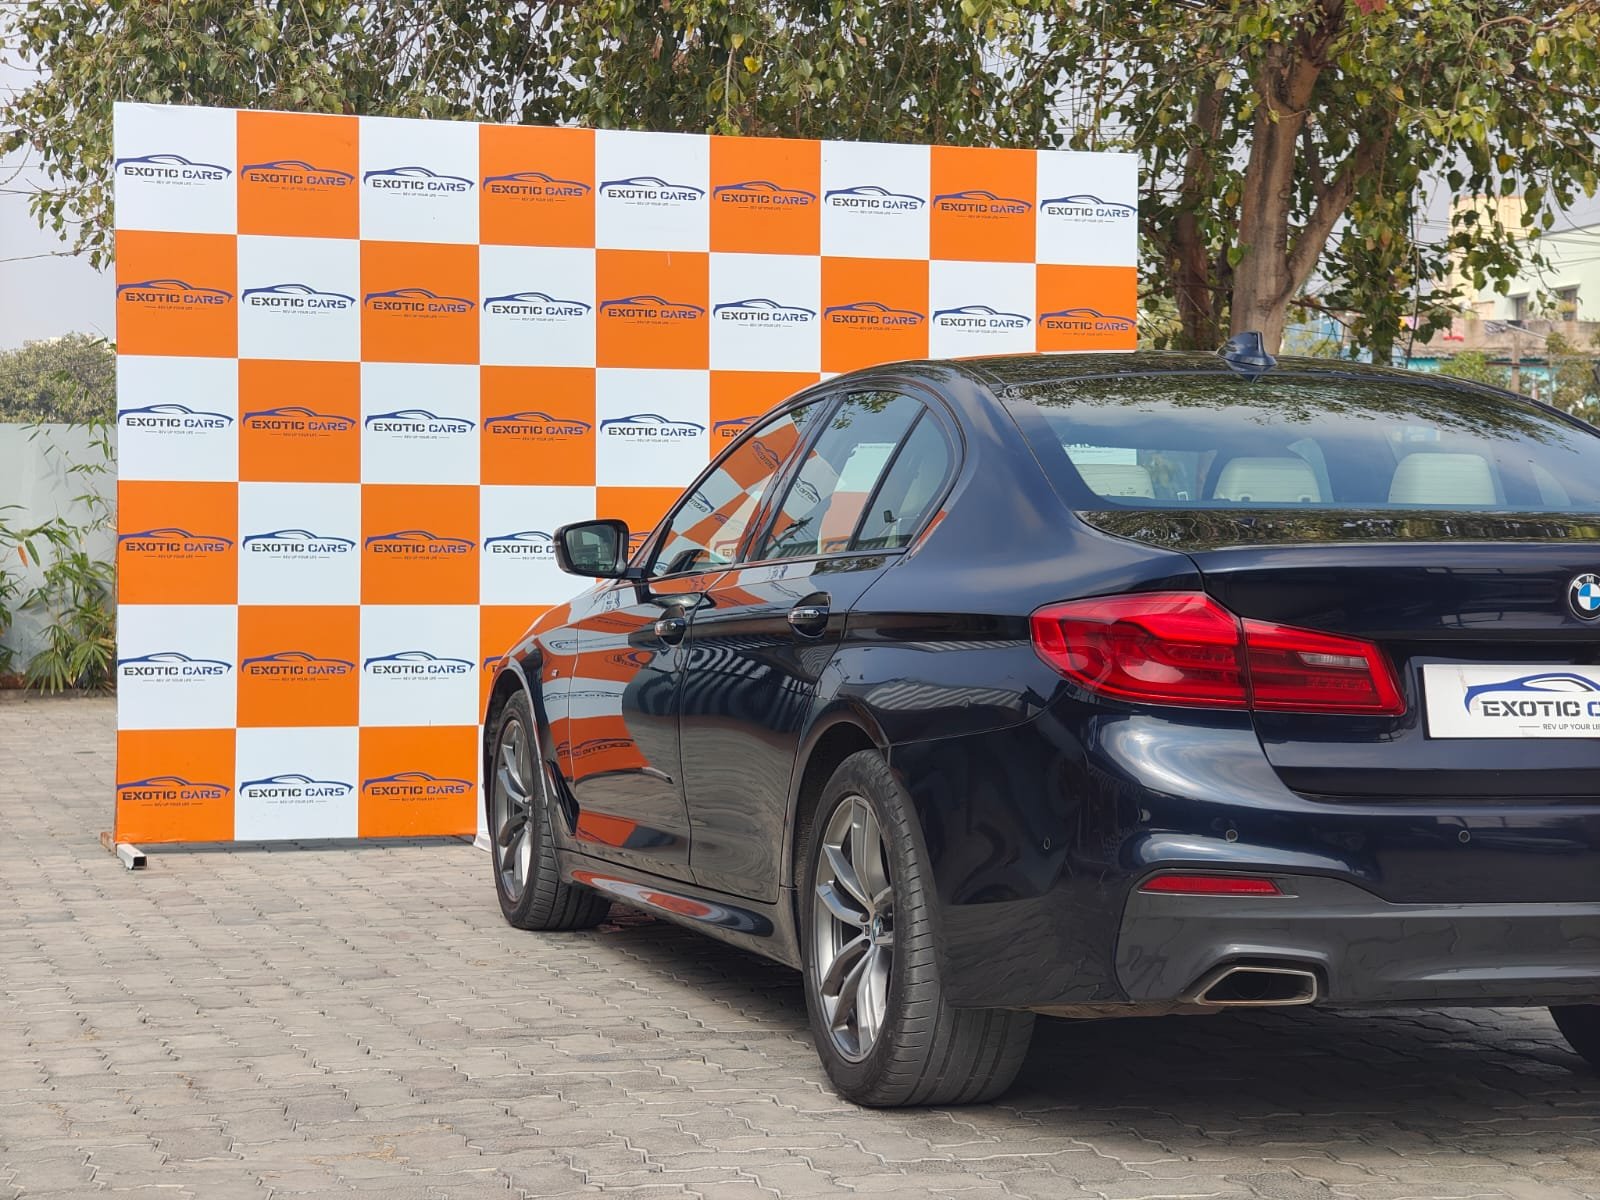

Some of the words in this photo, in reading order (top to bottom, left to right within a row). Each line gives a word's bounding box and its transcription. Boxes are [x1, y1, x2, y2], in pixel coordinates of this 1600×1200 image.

[124, 167, 179, 178] EXOTIC
[182, 169, 223, 180] CARS
[250, 173, 303, 184] EXOTIC
[307, 176, 346, 186] CARS
[372, 179, 424, 190] EXOTIC
[427, 182, 466, 192] CARS
[491, 185, 542, 195] EXOTIC
[545, 187, 583, 196] CARS
[607, 189, 657, 199] EXOTIC
[660, 191, 697, 201] CARS
[721, 194, 769, 204] EXOTIC
[773, 195, 808, 205] CARS
[832, 198, 879, 208] EXOTIC
[883, 200, 917, 210] CARS
[941, 203, 987, 212] EXOTIC
[990, 204, 1024, 214] CARS
[1047, 207, 1093, 216] EXOTIC
[1096, 208, 1130, 218] CARS
[125, 292, 180, 303] EXOTIC
[184, 294, 224, 304] CARS
[251, 297, 304, 307] EXOTIC
[308, 299, 347, 309] CARS
[373, 301, 425, 311] EXOTIC
[428, 303, 466, 313] CARS
[492, 305, 542, 315] EXOTIC
[546, 306, 583, 316] CARS
[608, 309, 657, 318] EXOTIC
[660, 310, 697, 319] CARS
[721, 312, 769, 321] EXOTIC
[773, 313, 808, 322] CARS
[832, 315, 879, 324] EXOTIC
[882, 316, 917, 325] CARS
[940, 318, 986, 327] EXOTIC
[990, 319, 1024, 328] CARS
[1046, 321, 1092, 330] EXOTIC
[1095, 322, 1128, 331] CARS
[126, 418, 180, 427] EXOTIC
[184, 419, 225, 428] CARS
[251, 420, 304, 430] EXOTIC
[308, 421, 347, 431] CARS
[373, 423, 425, 432] EXOTIC
[429, 424, 467, 433] CARS
[492, 425, 543, 434] EXOTIC
[546, 426, 583, 435] CARS
[608, 427, 657, 436] EXOTIC
[661, 428, 697, 436] CARS
[125, 543, 180, 551] EXOTIC
[184, 543, 224, 552] CARS
[251, 543, 304, 552] EXOTIC
[308, 544, 347, 552] CARS
[373, 544, 425, 553] EXOTIC
[429, 544, 467, 553] CARS
[493, 545, 542, 553] EXOTIC
[1573, 575, 1600, 589] BM
[124, 667, 179, 676] EXOTIC
[183, 666, 223, 675] CARS
[250, 666, 303, 675] EXOTIC
[307, 665, 346, 674] CARS
[372, 665, 424, 674] EXOTIC
[428, 665, 466, 674] CARS
[1481, 701, 1580, 716] EXOTIC
[122, 791, 177, 801] EXOTIC
[181, 789, 221, 799] CARS
[248, 788, 301, 798] EXOTIC
[305, 787, 344, 797] CARS
[371, 786, 423, 796] EXOTIC
[426, 785, 465, 794] CARS
